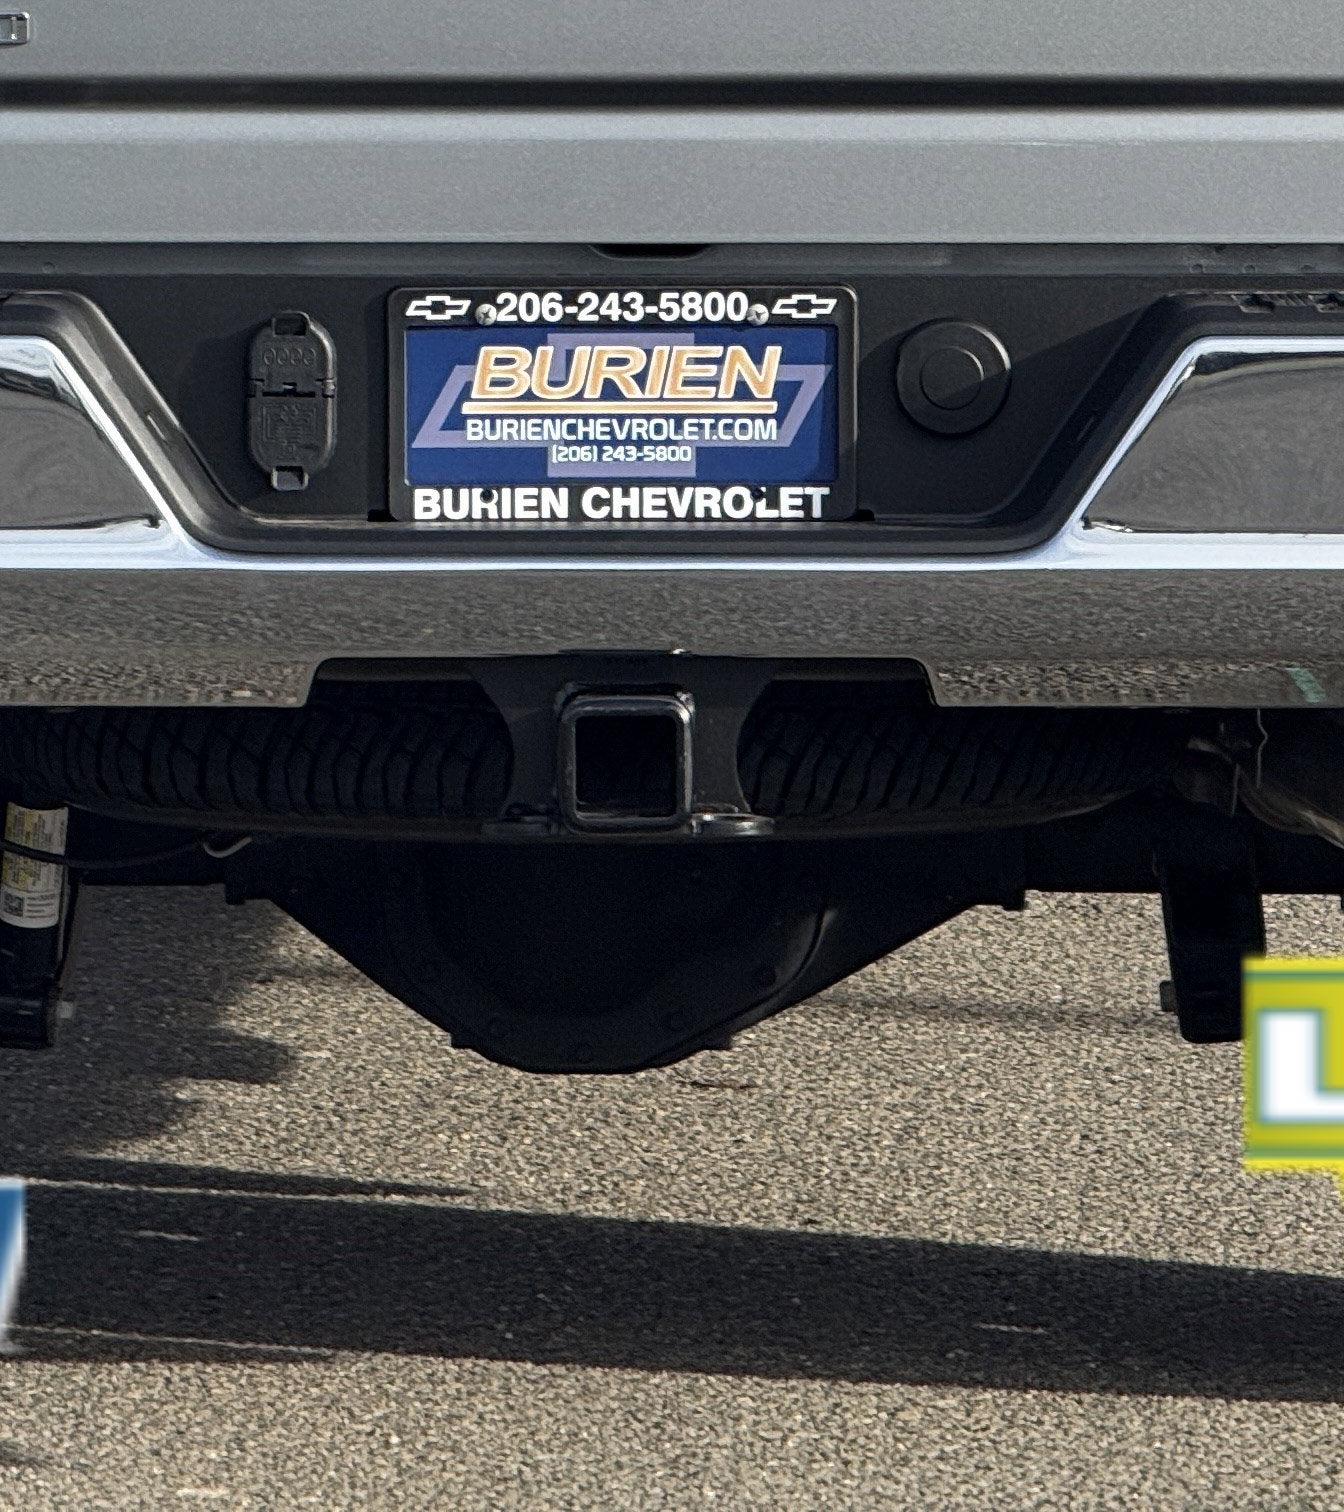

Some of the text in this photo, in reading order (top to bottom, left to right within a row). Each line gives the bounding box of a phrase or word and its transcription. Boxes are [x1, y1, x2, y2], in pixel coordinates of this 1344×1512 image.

[496, 292, 748, 322] 206-243-5800
[470, 345, 782, 400] BURIEN
[466, 418, 777, 441] BURIENCHEVROLET.COM
[602, 445, 692, 463] 243-5800
[413, 487, 830, 520] BURIEN CHEVROLET
